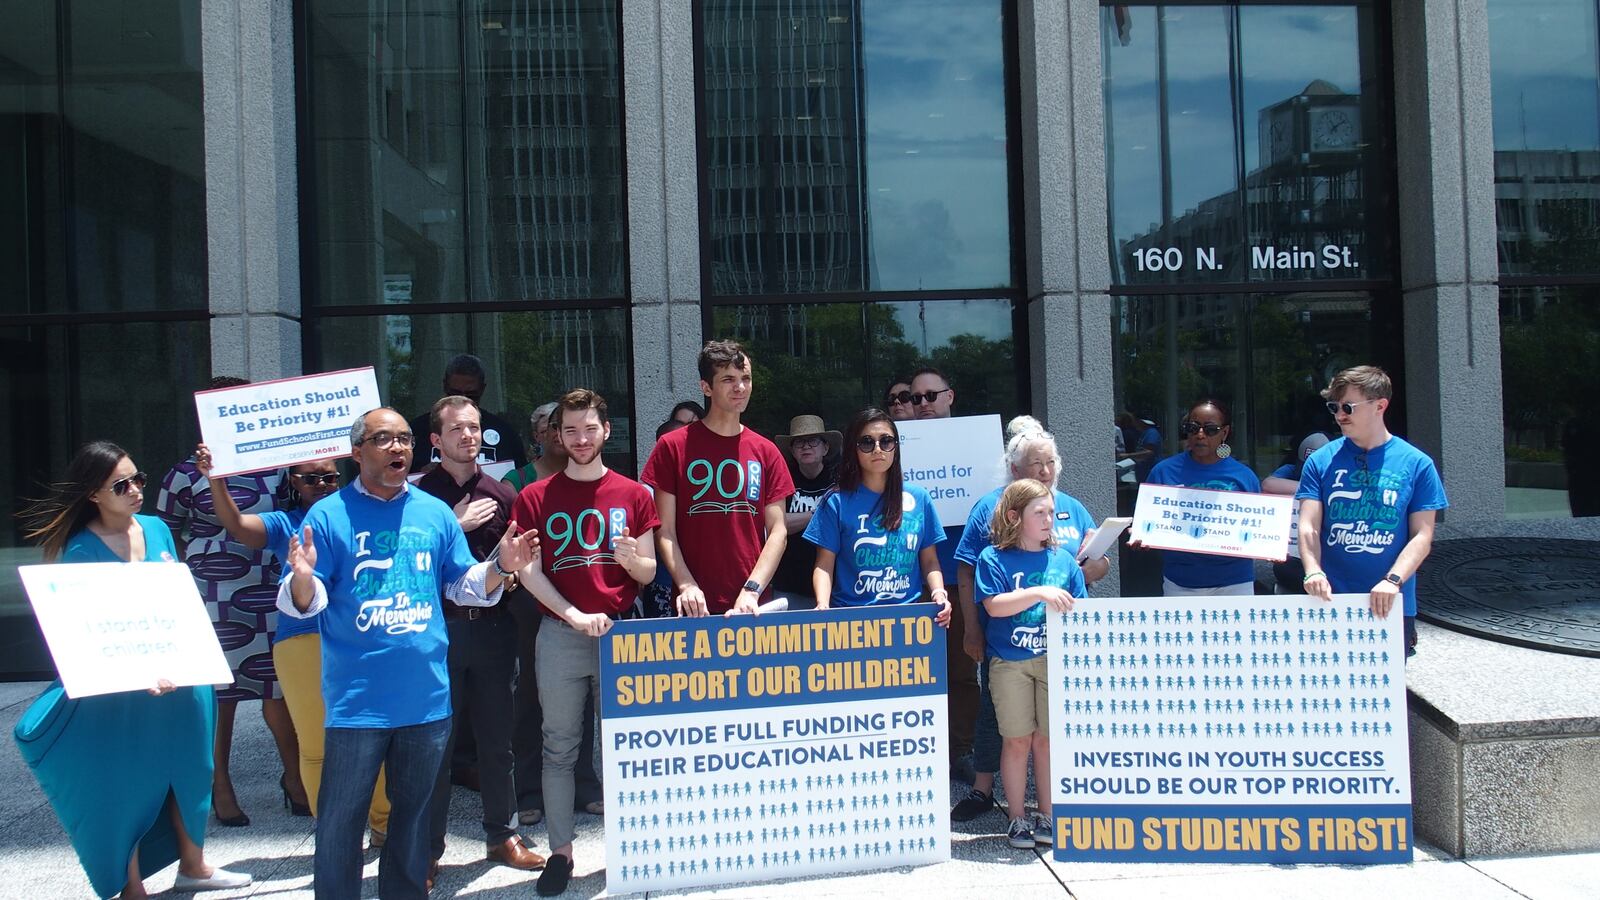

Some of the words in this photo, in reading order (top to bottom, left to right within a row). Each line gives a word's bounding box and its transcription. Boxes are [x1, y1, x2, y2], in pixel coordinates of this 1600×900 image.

[1132, 247, 1183, 271] 160
[1196, 247, 1222, 270] N.
[1252, 246, 1315, 270] Main
[1322, 245, 1359, 269] St.
[217, 398, 301, 418] Education
[305, 386, 361, 404] Should
[235, 421, 255, 433] Be
[260, 409, 323, 429] Priority
[327, 405, 350, 419] #1!
[686, 458, 744, 500] 90
[750, 463, 761, 498] ONE
[904, 466, 946, 481] stand
[951, 465, 972, 478] for
[1332, 469, 1348, 488] I
[1152, 496, 1222, 511] Education
[1226, 503, 1275, 516] Should
[1162, 510, 1178, 519] Be
[1182, 511, 1236, 527] Priority
[1241, 518, 1261, 527] #1!
[546, 508, 605, 556] 90
[857, 513, 869, 534] I
[1156, 523, 1182, 532] STAND
[1203, 528, 1230, 536] STAND
[1354, 520, 1369, 533] In
[355, 531, 371, 557] I
[1253, 533, 1280, 541] STAND
[1327, 523, 1395, 554] Memphis
[854, 569, 911, 600] Memphis
[884, 566, 898, 580] In
[395, 591, 411, 609] In
[355, 597, 433, 635] Memphis
[612, 630, 687, 664] MAKE
[693, 630, 711, 659] A
[717, 618, 895, 657] COMMITMENT
[900, 616, 932, 646] TO
[616, 669, 741, 706] SUPPORT
[747, 666, 801, 696] OUR
[807, 656, 937, 693] CHILDREN.
[614, 725, 717, 751] PROVIDE
[724, 720, 777, 742] FULL
[782, 713, 885, 738] FUNDING
[892, 709, 935, 729] FOR
[618, 757, 686, 779] THEIR
[694, 744, 854, 772] EDUCATIONAL
[859, 737, 936, 757] NEEDS!
[1074, 752, 1182, 768] INVESTING
[1189, 752, 1210, 767] IN
[1216, 752, 1287, 768] YOUTH
[1292, 751, 1385, 768] SUCCESS
[1060, 778, 1151, 794] SHOULD
[1158, 778, 1182, 794] BE
[1188, 778, 1237, 794] OUR
[1246, 778, 1286, 794] TOP
[1292, 777, 1400, 794] PRIORITY.
[1056, 817, 1135, 850] FUND
[1142, 818, 1301, 851] STUDENTS
[1309, 818, 1407, 851] FIRST!
